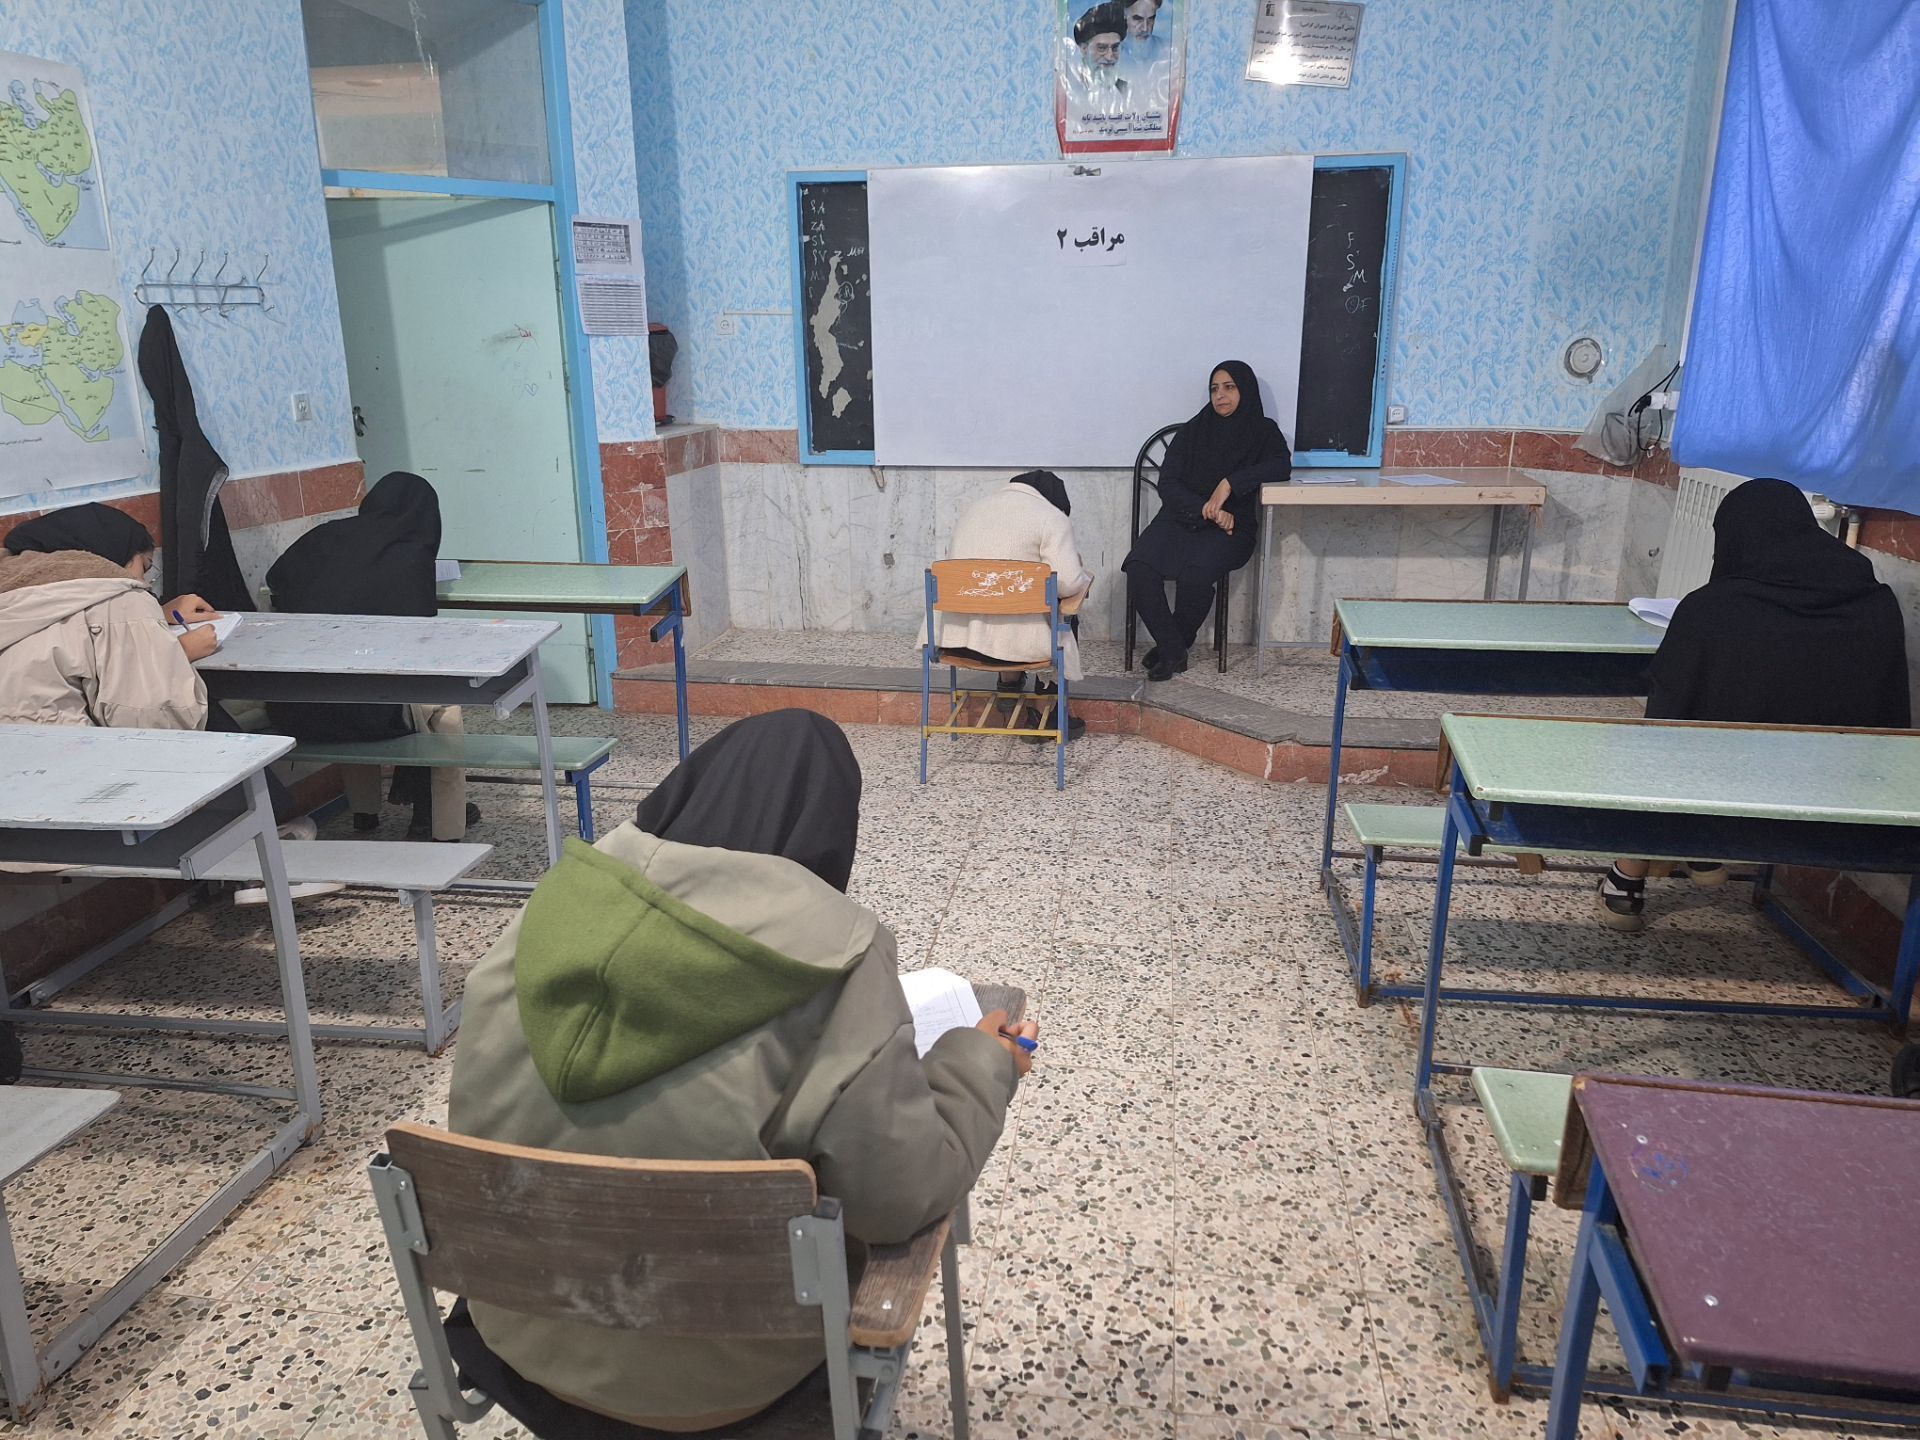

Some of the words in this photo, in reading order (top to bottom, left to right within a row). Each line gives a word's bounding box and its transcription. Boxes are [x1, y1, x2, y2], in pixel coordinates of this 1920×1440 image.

[1056, 227, 1068, 250] ۲
[1074, 226, 1125, 252] مراقب
[1346, 253, 1356, 271] S
